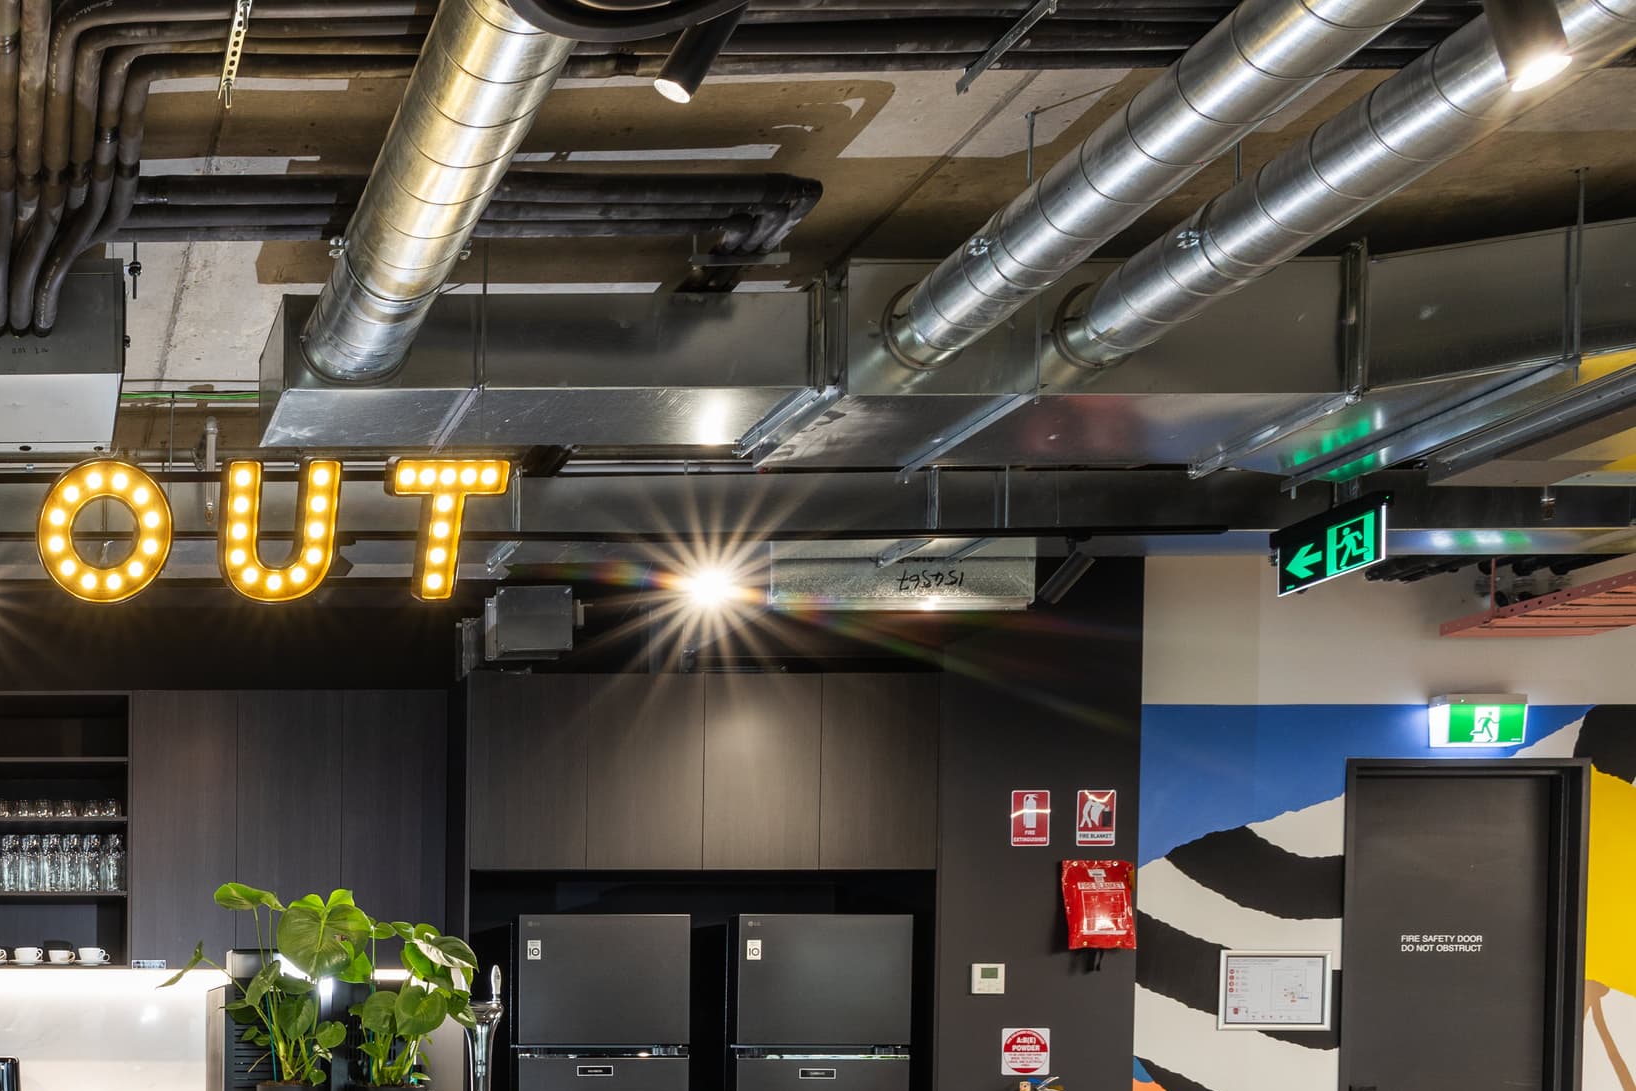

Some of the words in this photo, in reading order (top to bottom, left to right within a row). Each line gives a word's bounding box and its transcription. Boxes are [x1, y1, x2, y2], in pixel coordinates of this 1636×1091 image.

[36, 457, 510, 603] OUT
[1401, 934, 1421, 943] FIRE
[1422, 934, 1455, 943] SAFETY
[1457, 934, 1483, 943] DOOR
[1401, 944, 1415, 952] DO
[1416, 944, 1435, 952] NOT
[1436, 944, 1483, 952] OBSTRUCT
